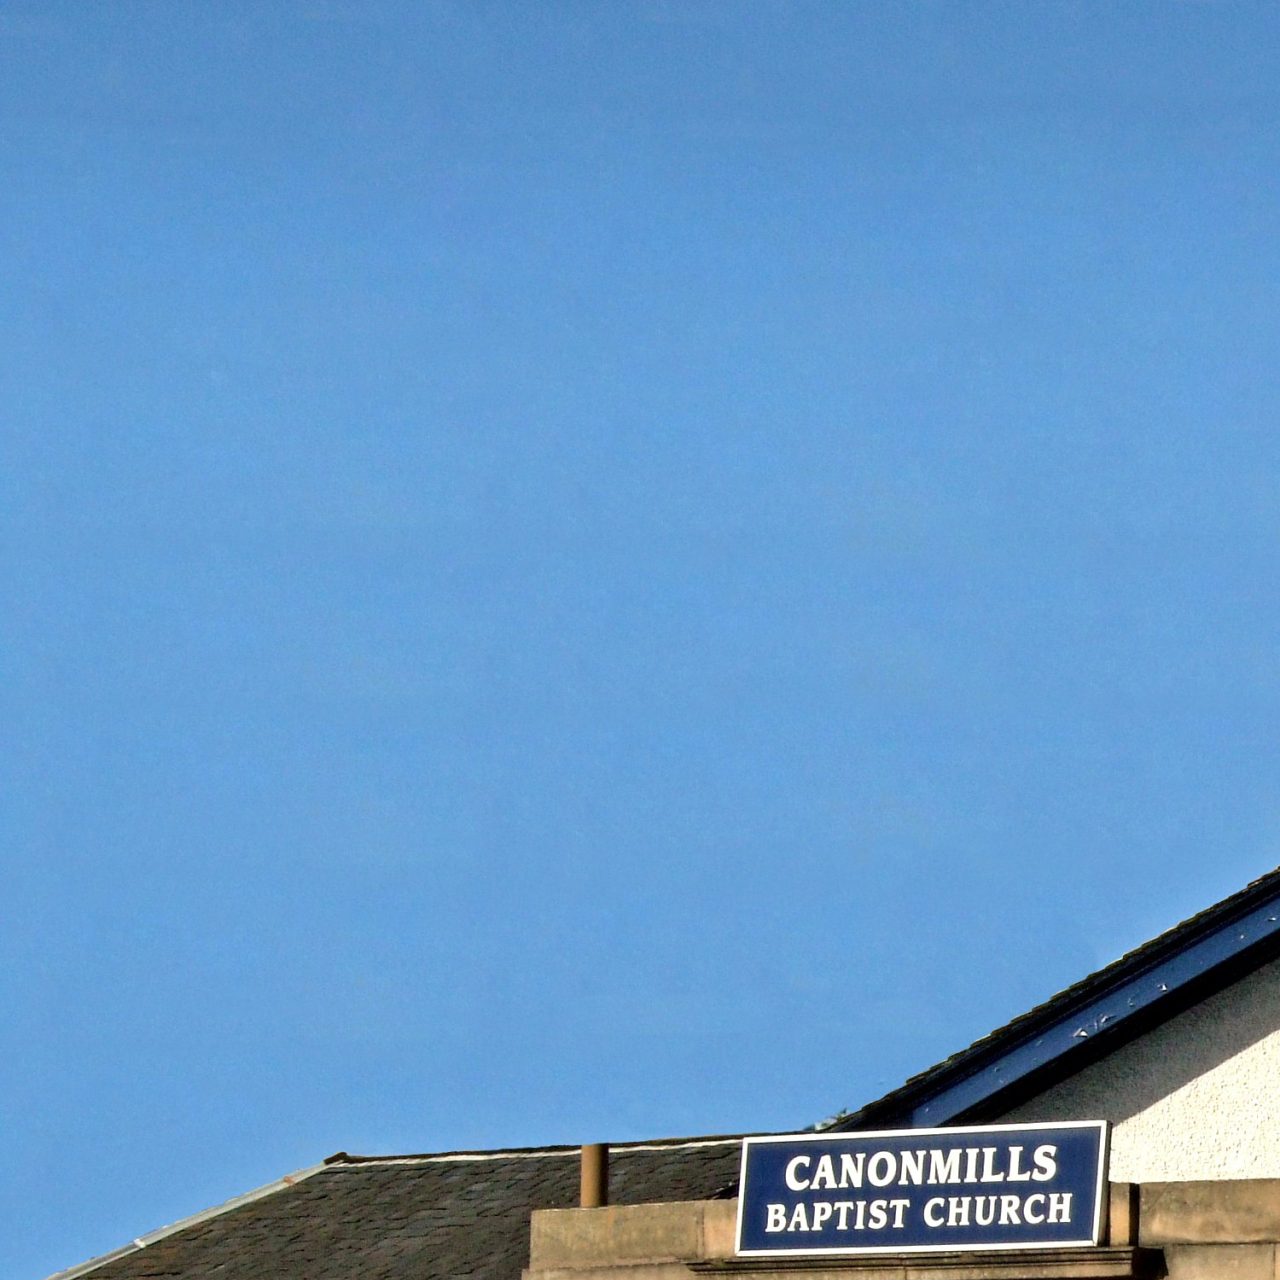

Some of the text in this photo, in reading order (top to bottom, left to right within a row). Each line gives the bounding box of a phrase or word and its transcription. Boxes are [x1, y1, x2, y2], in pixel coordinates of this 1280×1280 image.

[785, 1144, 1058, 1191] CANONMILLS
[765, 1192, 1073, 1233] BAPTIST CHURCH
